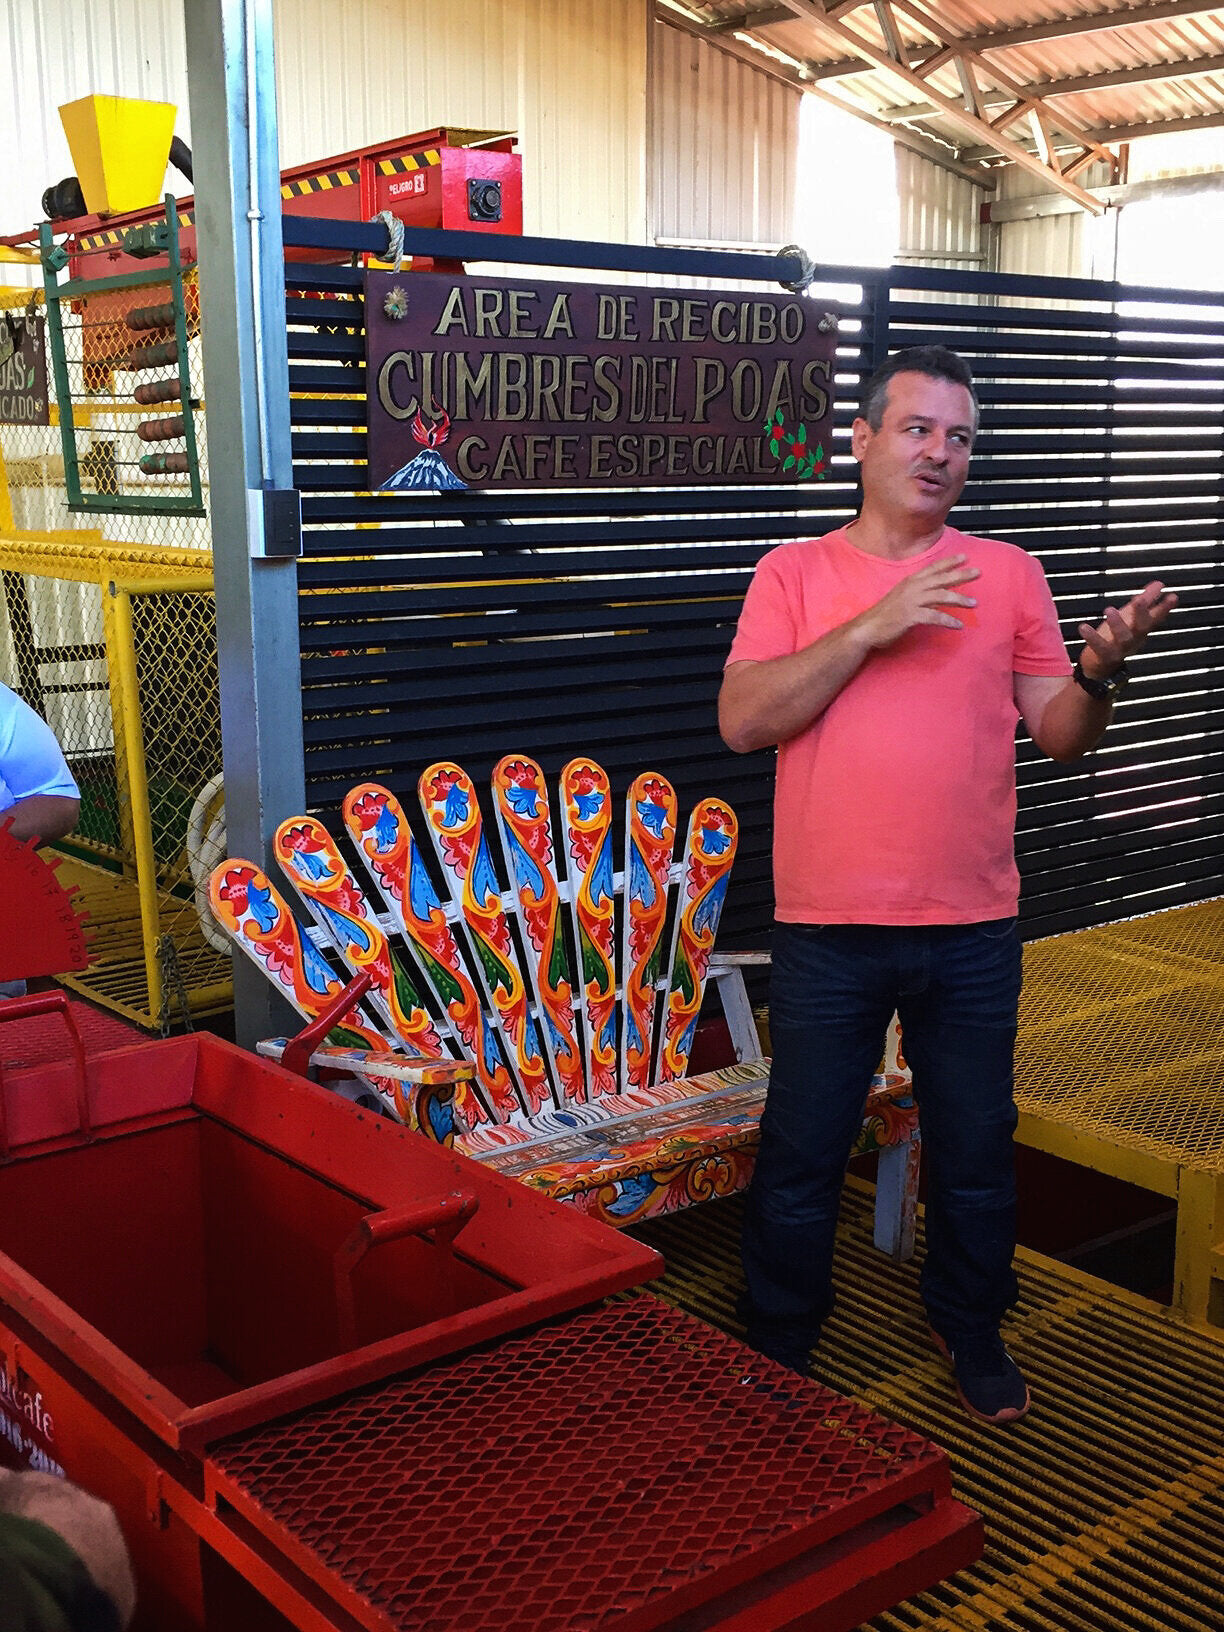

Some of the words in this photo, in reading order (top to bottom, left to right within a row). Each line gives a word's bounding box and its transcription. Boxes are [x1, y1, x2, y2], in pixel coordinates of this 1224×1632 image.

[434, 286, 575, 339] AREA
[597, 293, 640, 341] DE
[650, 297, 805, 344] RECIBO
[378, 351, 622, 422] CUMBRES
[629, 355, 684, 422] DEL
[692, 357, 831, 422] POAS
[457, 434, 579, 480] CAFE
[589, 434, 778, 479] ESPECIAL
